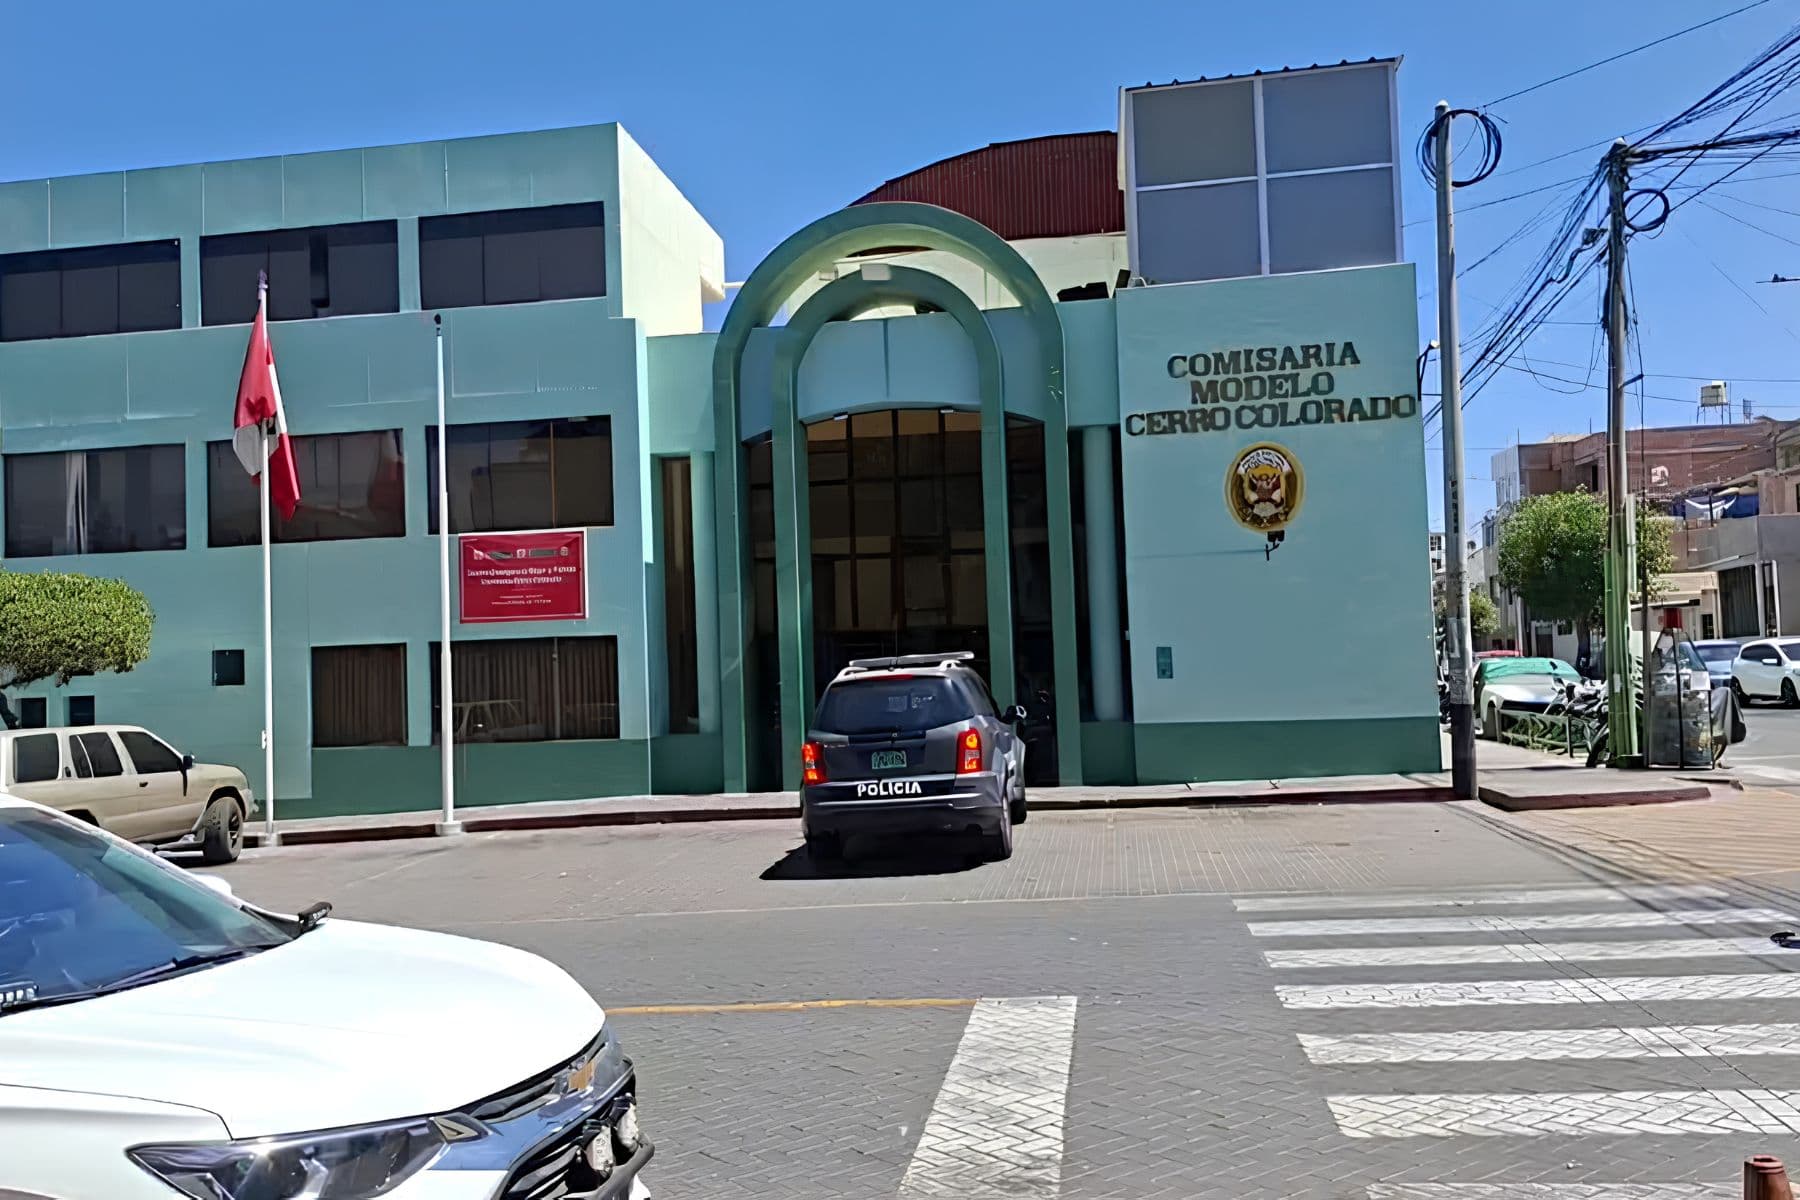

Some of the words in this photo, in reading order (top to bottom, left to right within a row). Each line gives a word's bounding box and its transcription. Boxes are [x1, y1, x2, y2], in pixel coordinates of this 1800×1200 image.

[1167, 341, 1360, 378] COMISARIA
[1191, 372, 1334, 404] MODELO
[1126, 407, 1231, 436] CERRO
[1235, 394, 1416, 429] COLORADO
[857, 780, 922, 797] POLICIA
